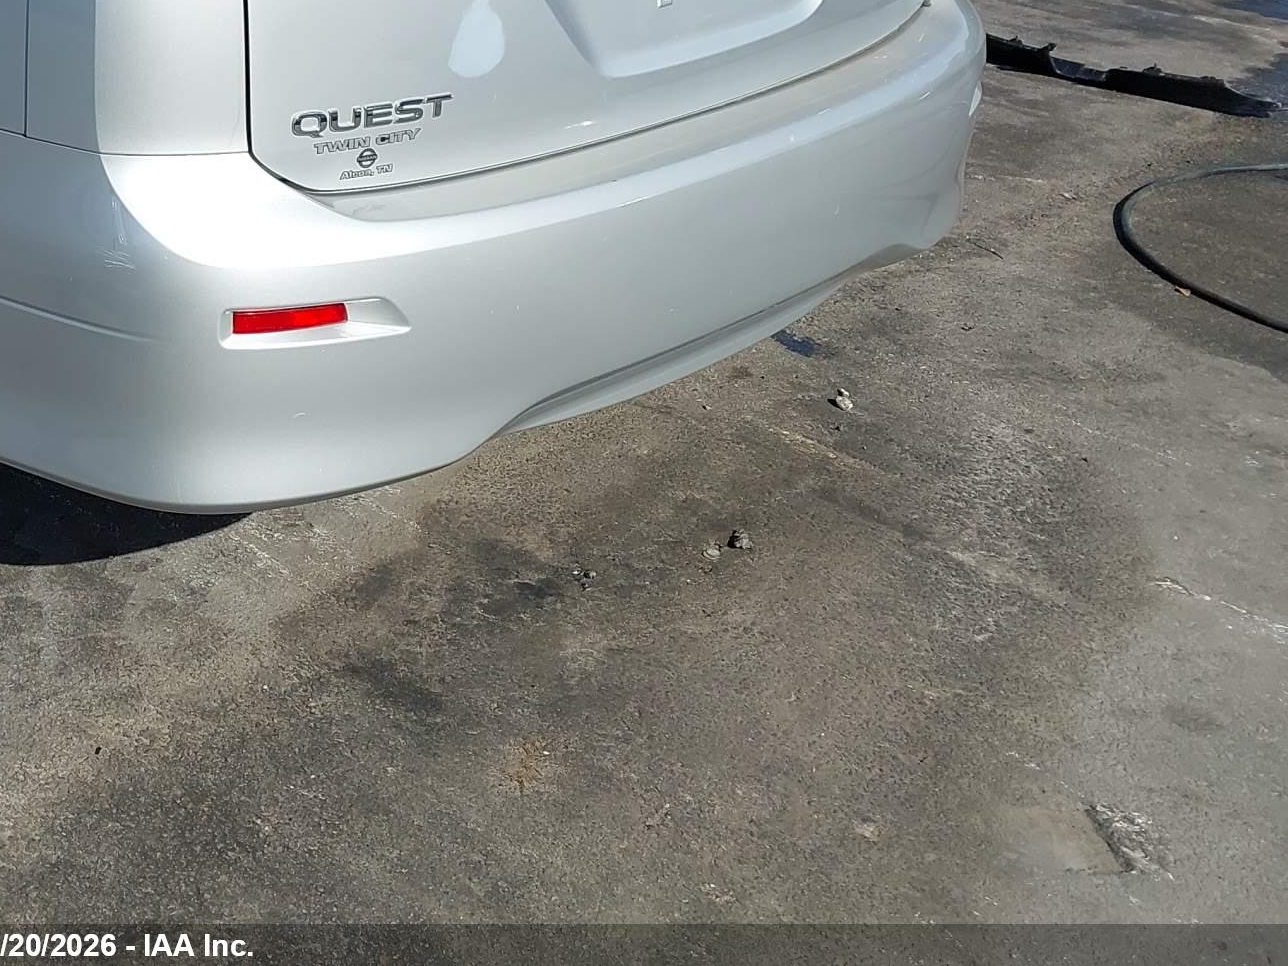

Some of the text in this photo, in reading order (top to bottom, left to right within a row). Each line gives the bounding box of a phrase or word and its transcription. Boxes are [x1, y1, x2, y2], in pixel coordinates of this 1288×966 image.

[291, 92, 454, 137] QUEST
[314, 128, 421, 154] TWIN CITY
[376, 164, 393, 174] TN
